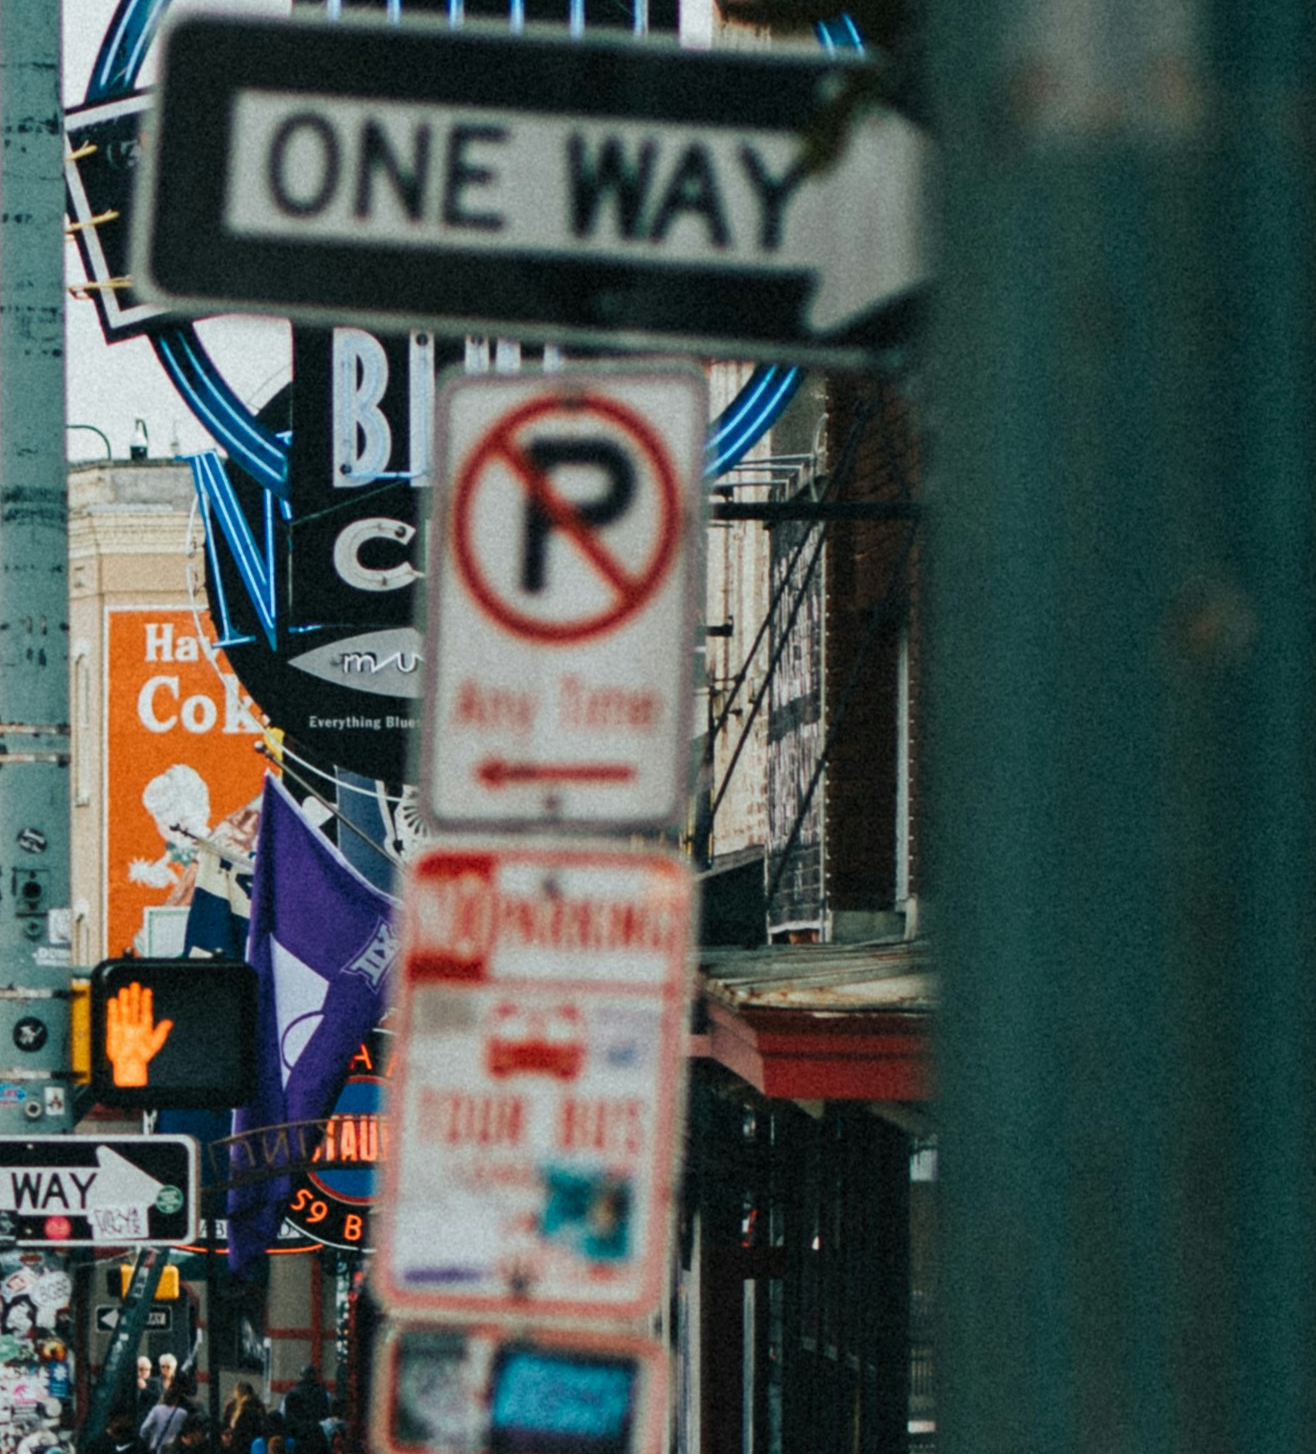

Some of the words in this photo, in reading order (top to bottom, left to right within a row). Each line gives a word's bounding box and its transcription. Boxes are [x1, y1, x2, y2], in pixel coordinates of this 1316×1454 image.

[265, 109, 509, 233] ONE
[568, 132, 805, 251] WAY
[137, 674, 270, 733] Cok
[310, 716, 380, 731] Everything
[386, 716, 421, 729] Blue
[11, 1171, 99, 1210] WAY
